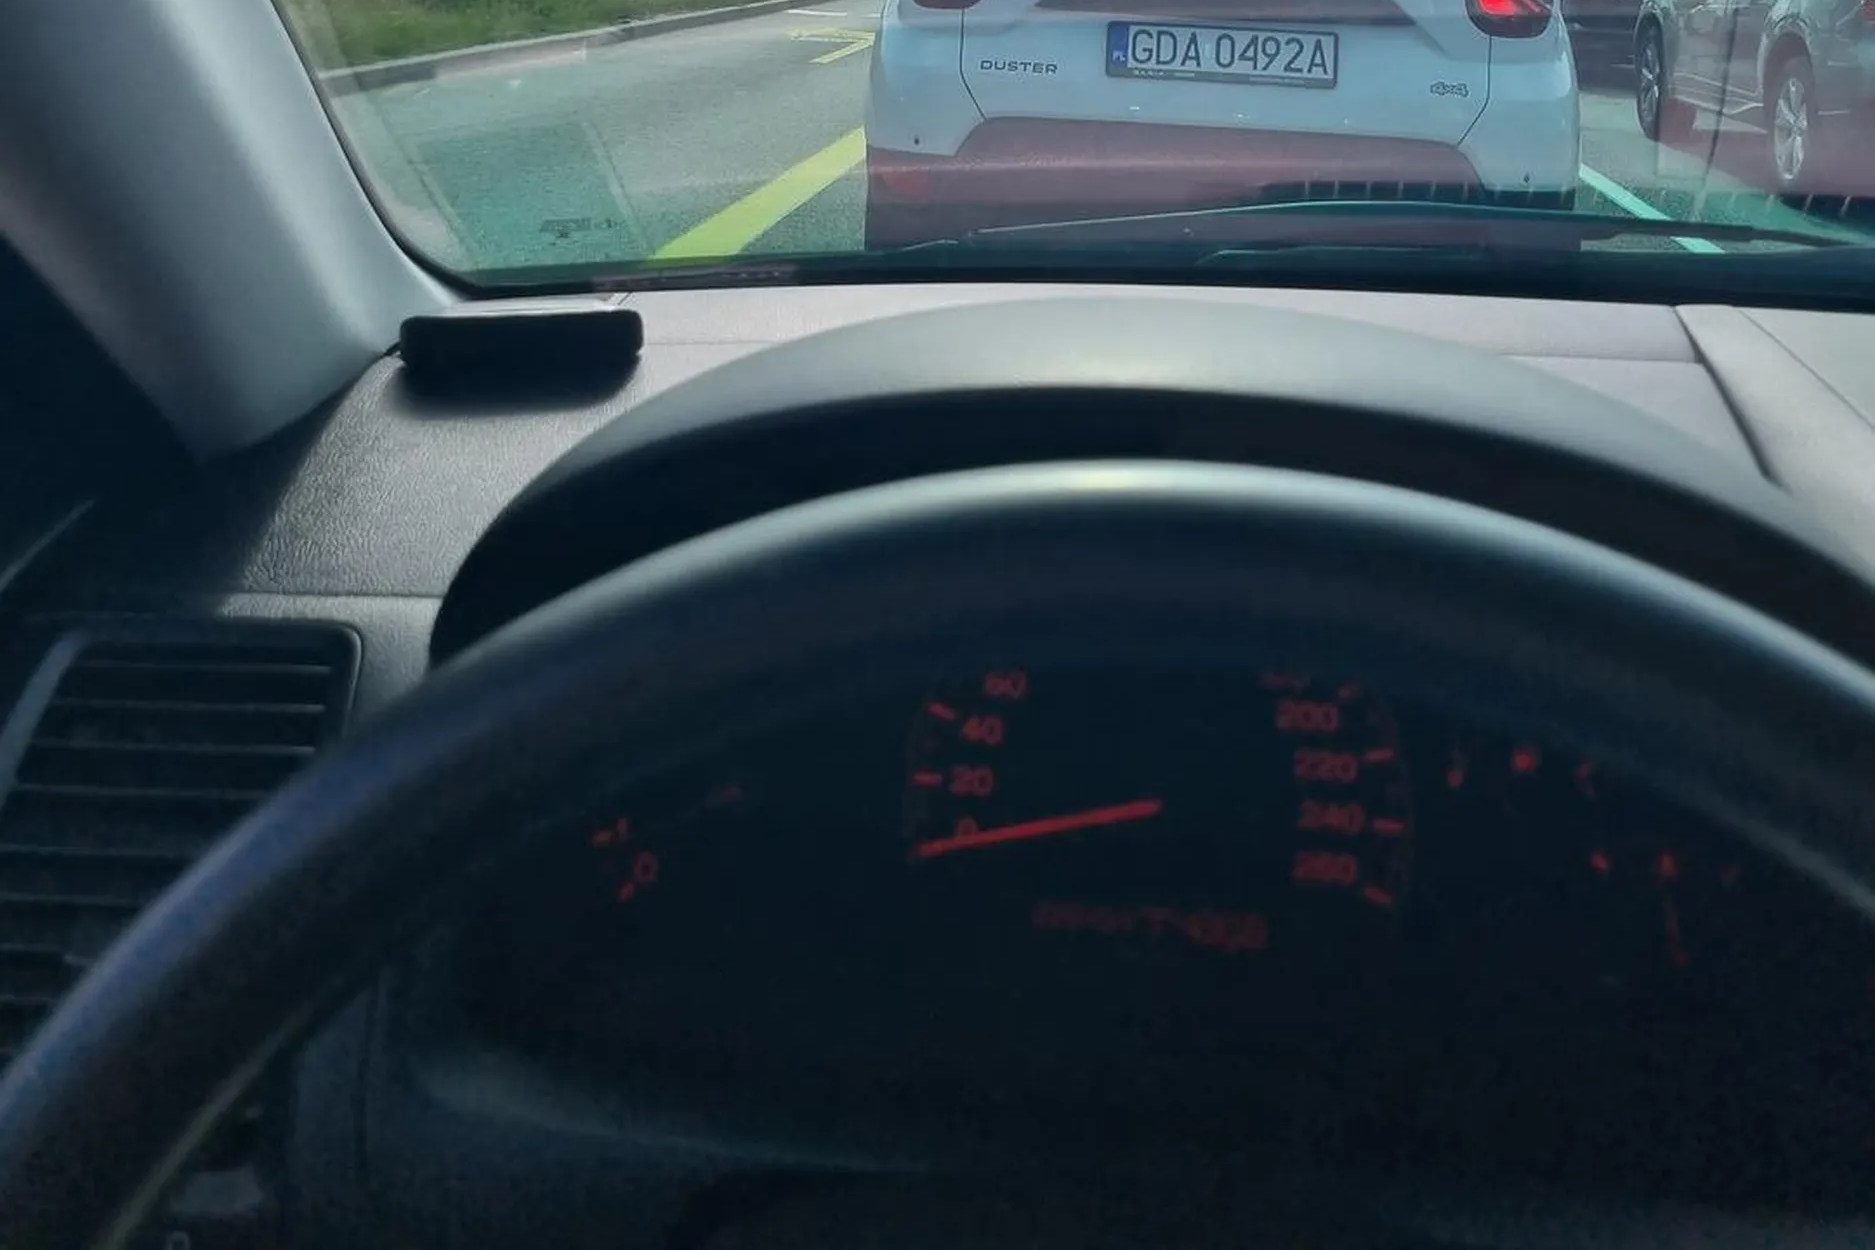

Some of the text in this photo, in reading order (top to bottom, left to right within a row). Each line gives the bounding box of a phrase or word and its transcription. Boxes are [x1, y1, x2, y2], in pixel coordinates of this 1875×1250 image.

[980, 59, 1058, 74] DUSTER
[1131, 29, 1329, 76] GDA 0492A
[949, 765, 995, 797] 20
